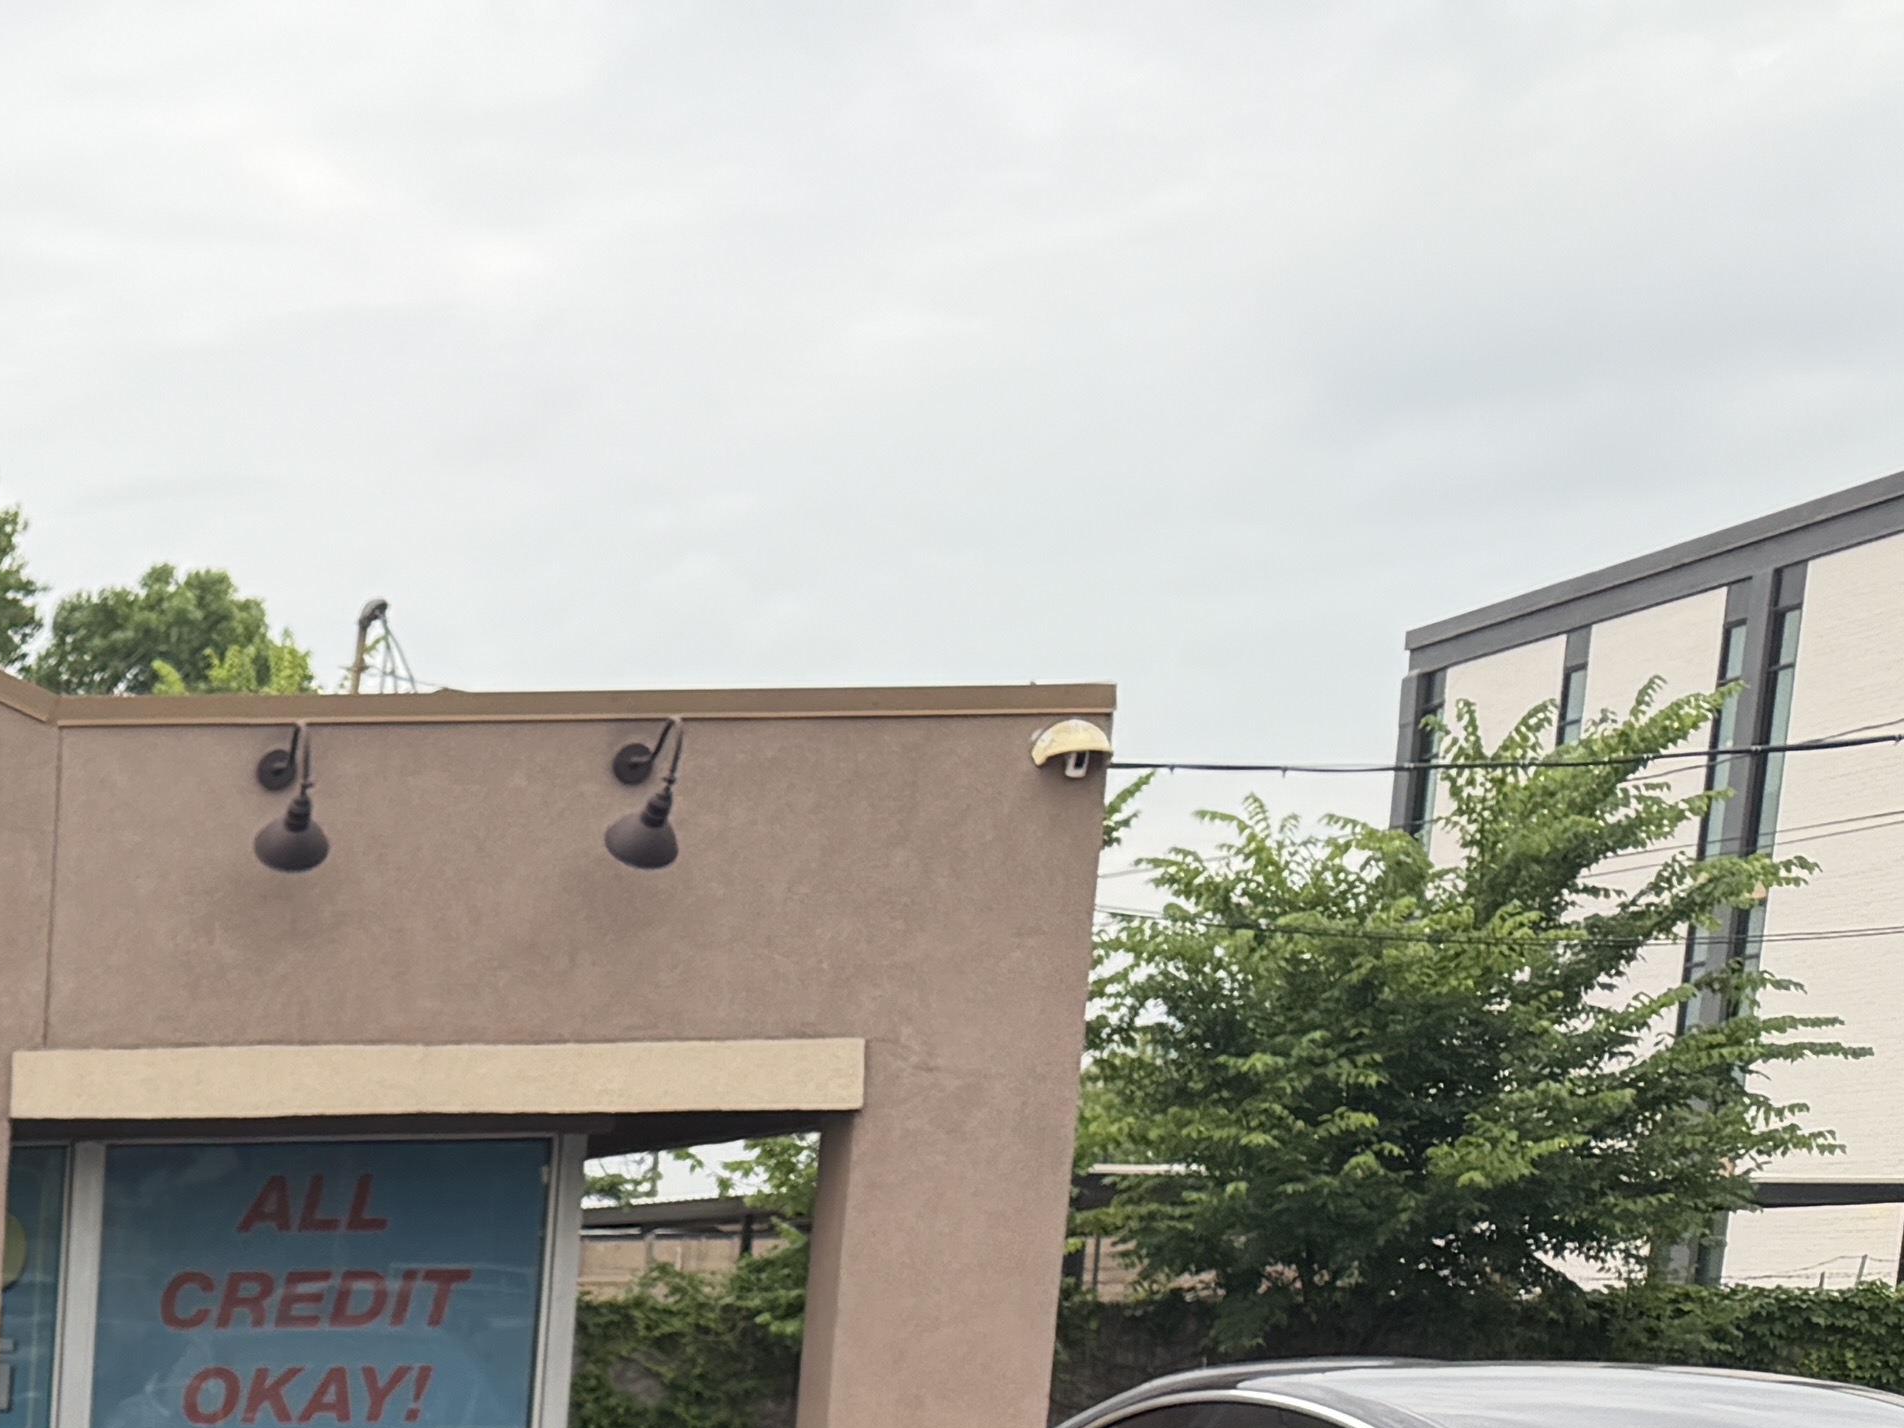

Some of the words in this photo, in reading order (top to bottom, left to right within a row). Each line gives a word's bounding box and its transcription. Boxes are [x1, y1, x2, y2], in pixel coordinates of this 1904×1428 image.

[238, 1174, 389, 1232] ALL
[160, 1268, 473, 1331] CREDIT
[183, 1364, 433, 1426] OKAY!
